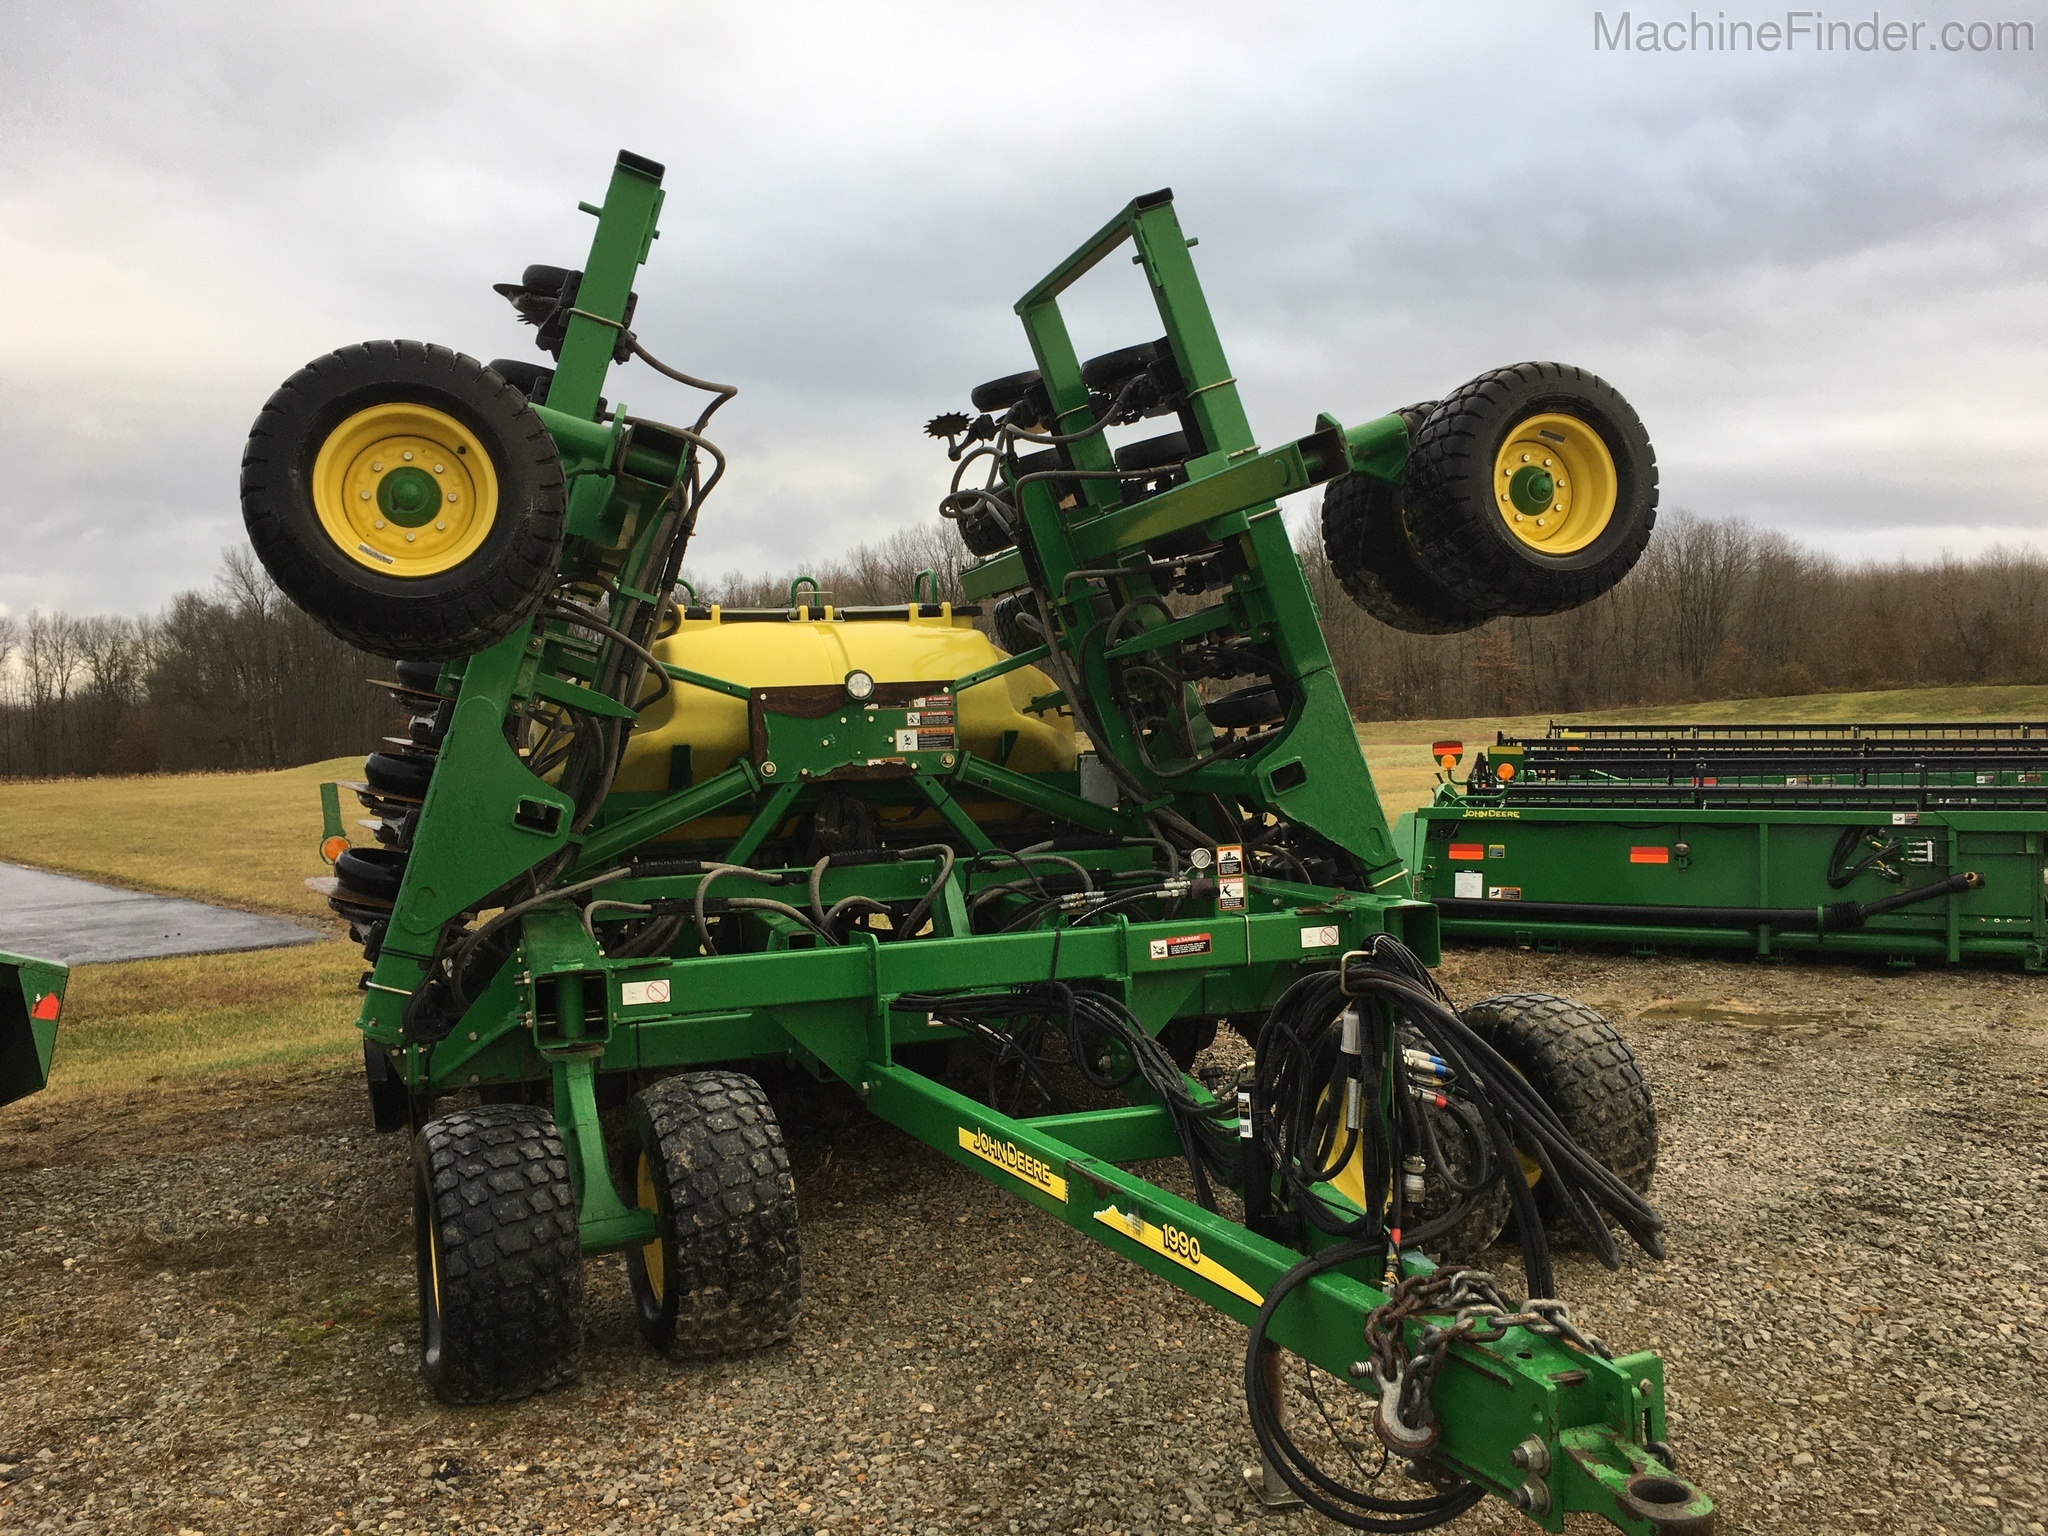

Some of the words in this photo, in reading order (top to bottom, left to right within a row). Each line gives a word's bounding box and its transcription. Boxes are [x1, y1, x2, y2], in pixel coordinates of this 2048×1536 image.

[974, 1126, 1008, 1166] JOHN
[1006, 1141, 1052, 1188] DEERE
[1161, 1223, 1202, 1264] 1990
